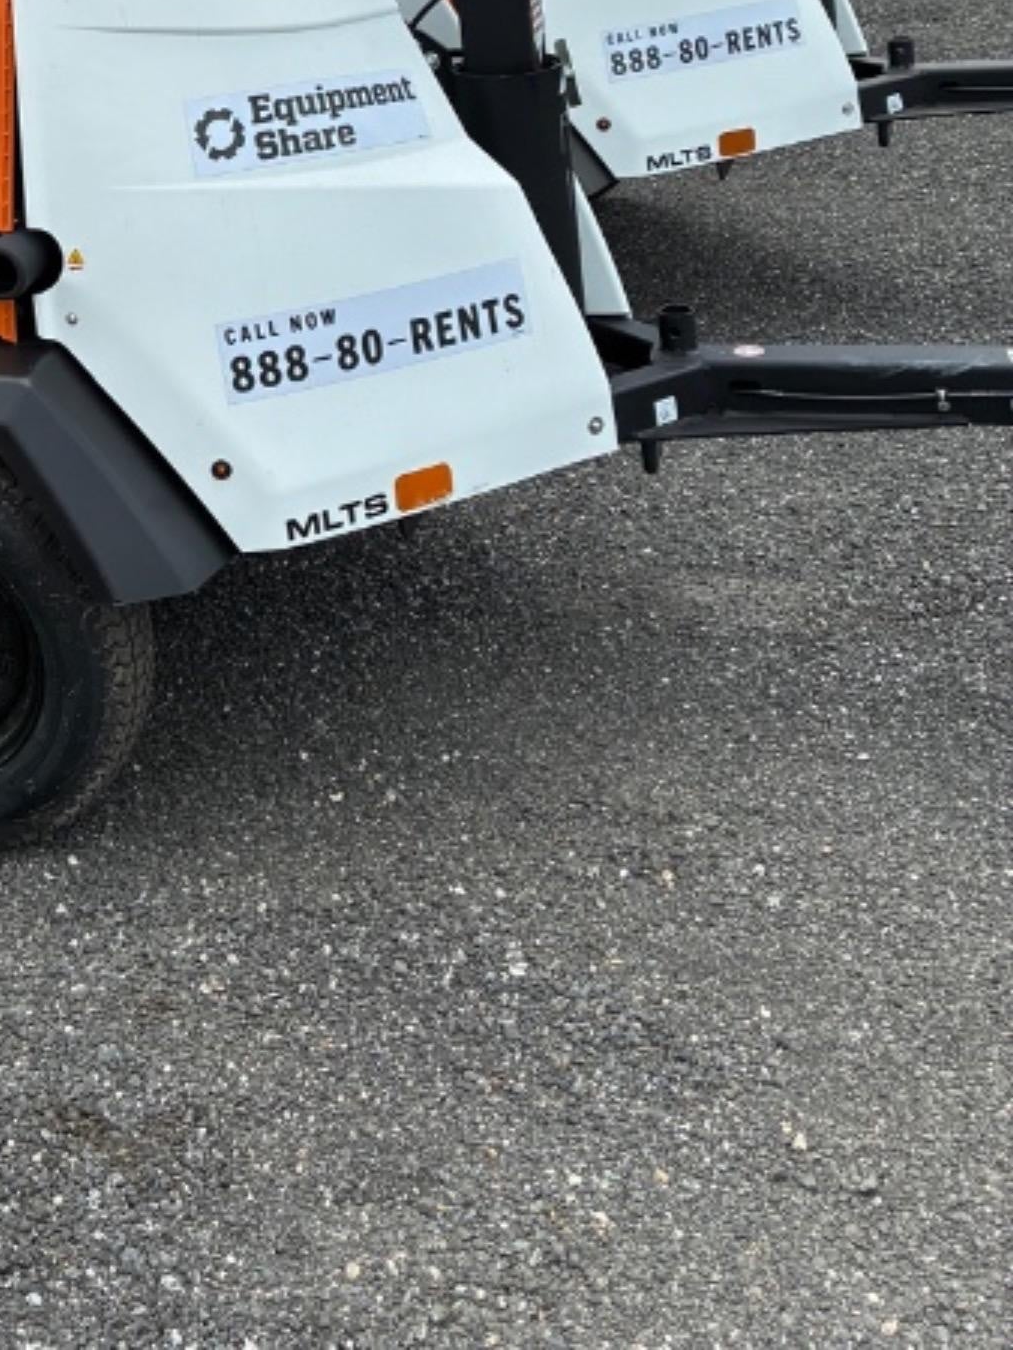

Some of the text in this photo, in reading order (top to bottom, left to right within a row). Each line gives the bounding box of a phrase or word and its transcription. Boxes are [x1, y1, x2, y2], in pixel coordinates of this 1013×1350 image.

[610, 17, 801, 76] 888-80-RENTS
[247, 75, 417, 127] Equipment
[254, 123, 357, 160] Share
[646, 144, 712, 171] MLTS
[223, 307, 337, 346] CALL NOW
[230, 293, 526, 393] 888-80-RENTS
[286, 492, 389, 541] MLTS
